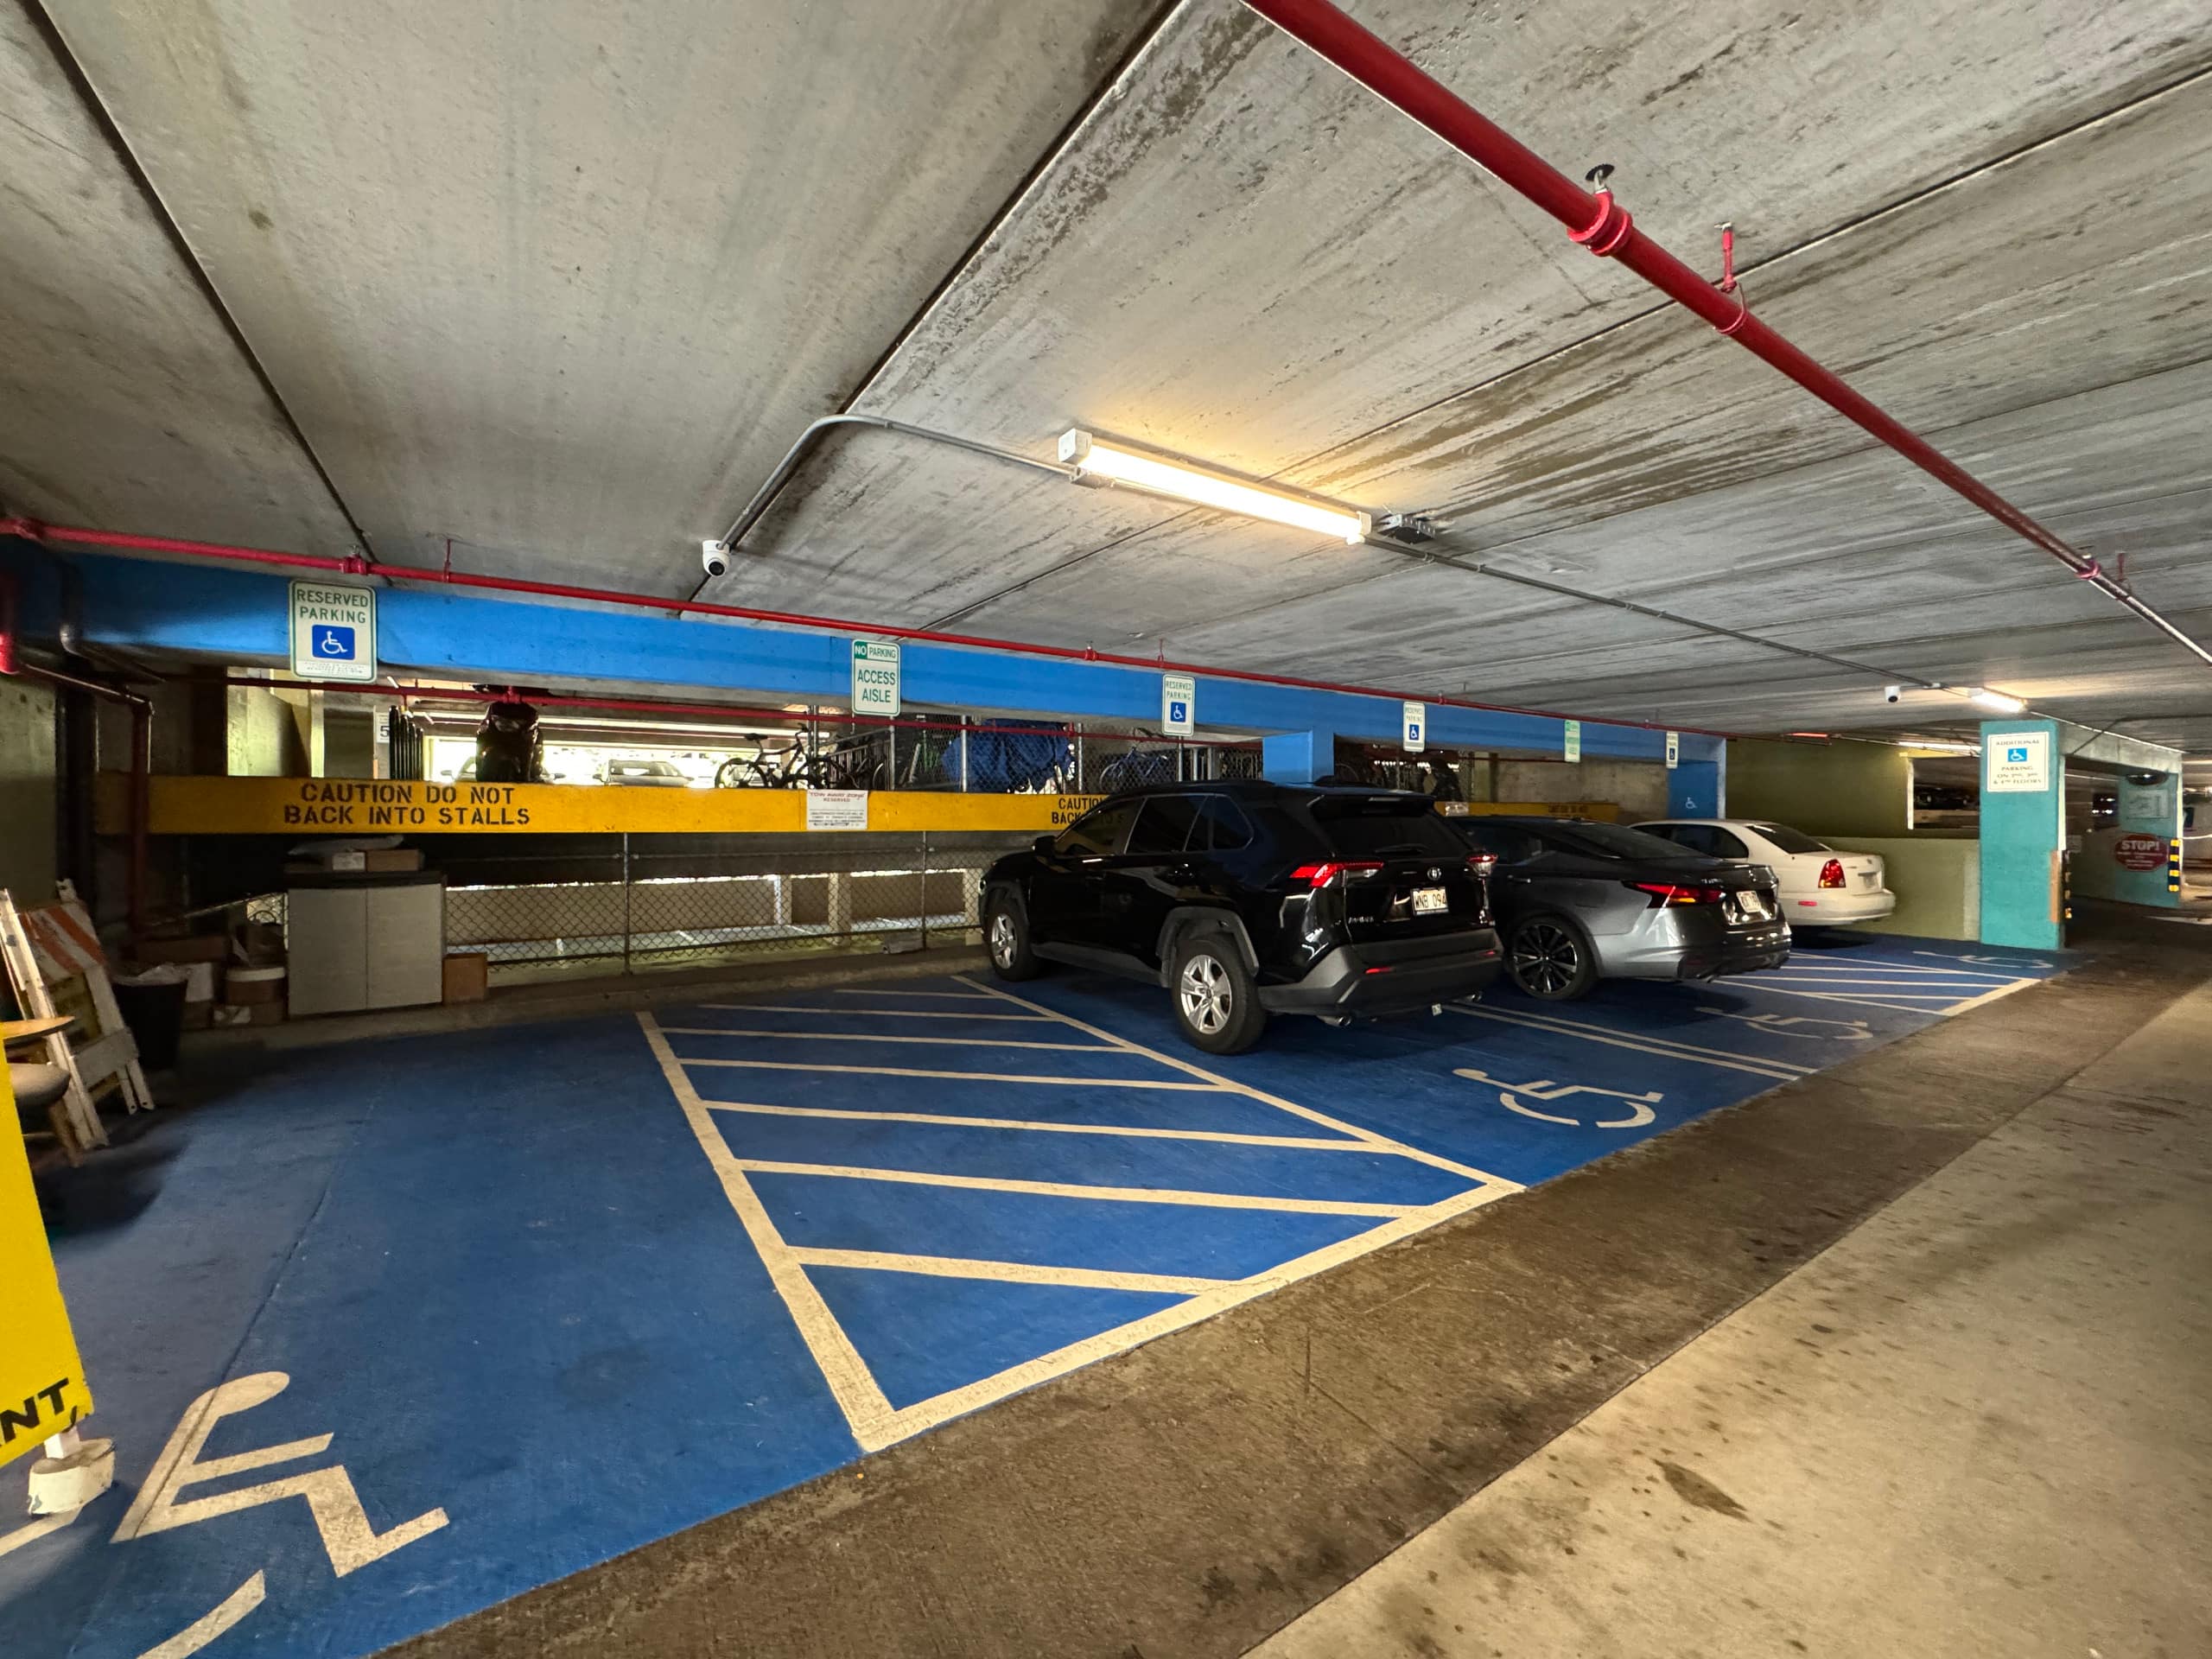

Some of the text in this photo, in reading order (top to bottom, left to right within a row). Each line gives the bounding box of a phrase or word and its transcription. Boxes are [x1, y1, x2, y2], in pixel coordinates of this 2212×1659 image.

[296, 589, 368, 607] RESERVED
[300, 606, 365, 623] PARKING
[855, 645, 896, 658] NO PARKING
[857, 669, 896, 685] ACCESS
[1166, 680, 1192, 690] RESERVED
[861, 688, 892, 702] AISLE
[1166, 690, 1192, 700] PARKING
[301, 783, 515, 804] CAUTION DO NOT
[1058, 798, 1103, 810] CAUTIO
[284, 804, 530, 825] BACK INTO STALLS
[0, 1376, 69, 1447] NT
